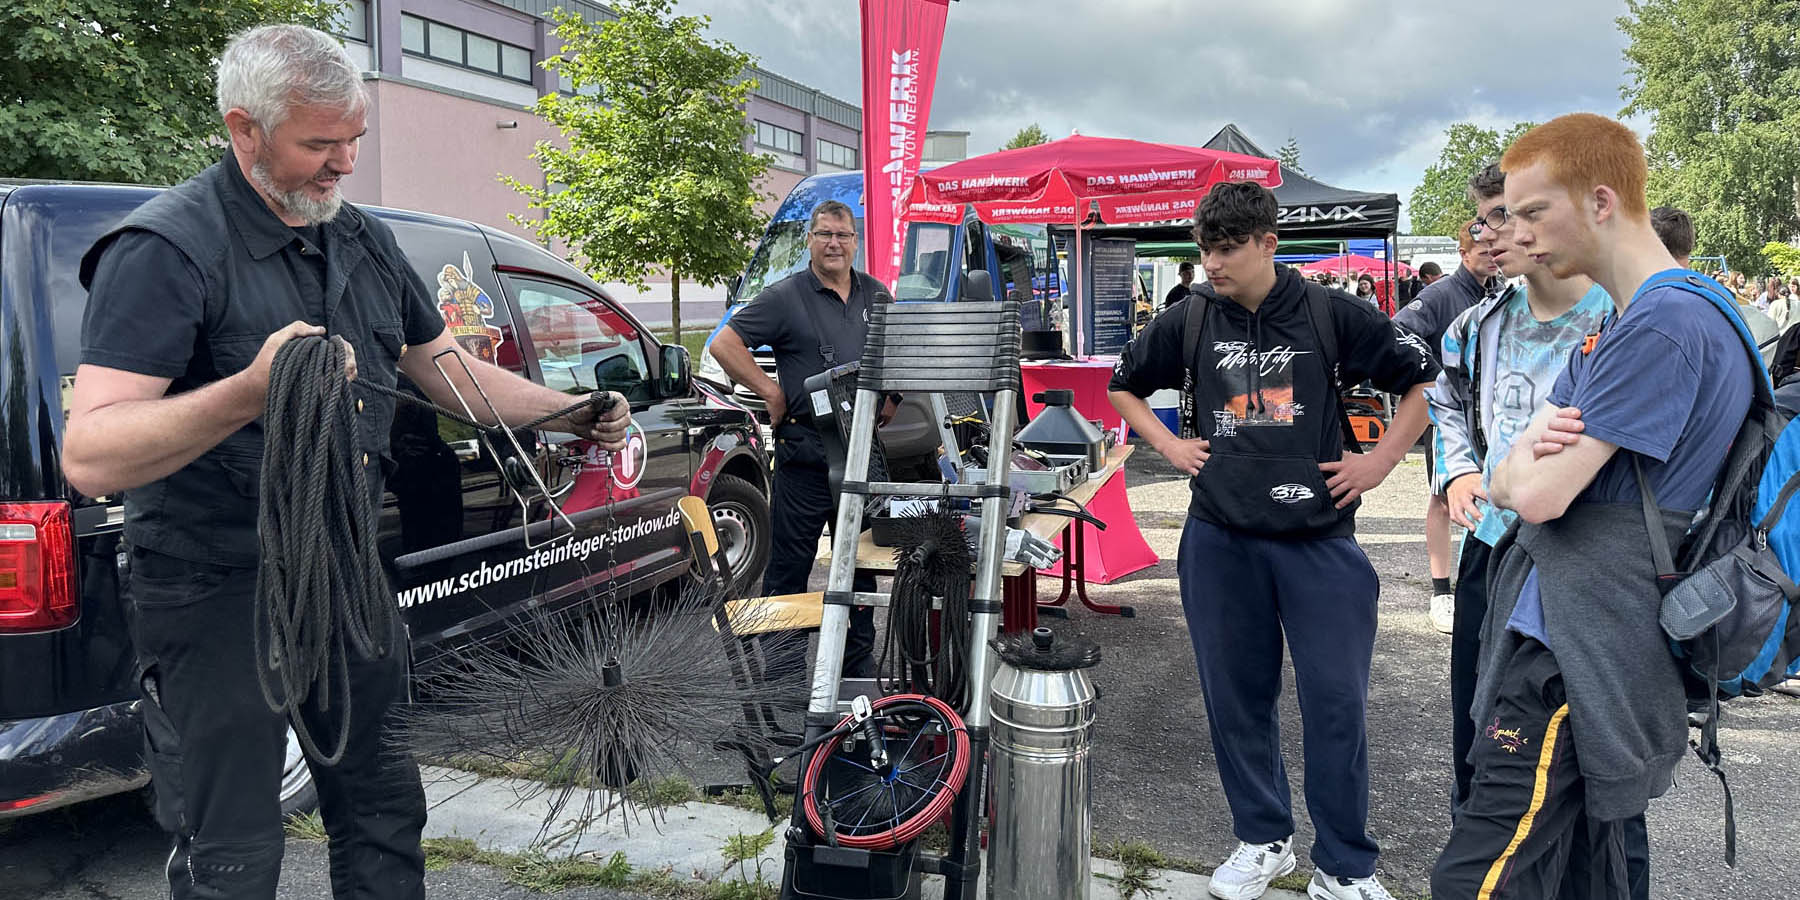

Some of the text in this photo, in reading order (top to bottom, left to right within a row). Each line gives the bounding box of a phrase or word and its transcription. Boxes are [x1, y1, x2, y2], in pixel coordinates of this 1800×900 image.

[904, 47, 920, 125] NEBENAN.
[904, 130, 916, 160] VON
[938, 174, 1029, 192] DAS HANDWERK
[1086, 176, 1115, 186] DAS
[1119, 169, 1196, 184] HANDWERK
[1277, 204, 1369, 225] 24MX
[1271, 485, 1315, 500] 313
[396, 507, 681, 609] www.schornsteinfeger-storkow.de
